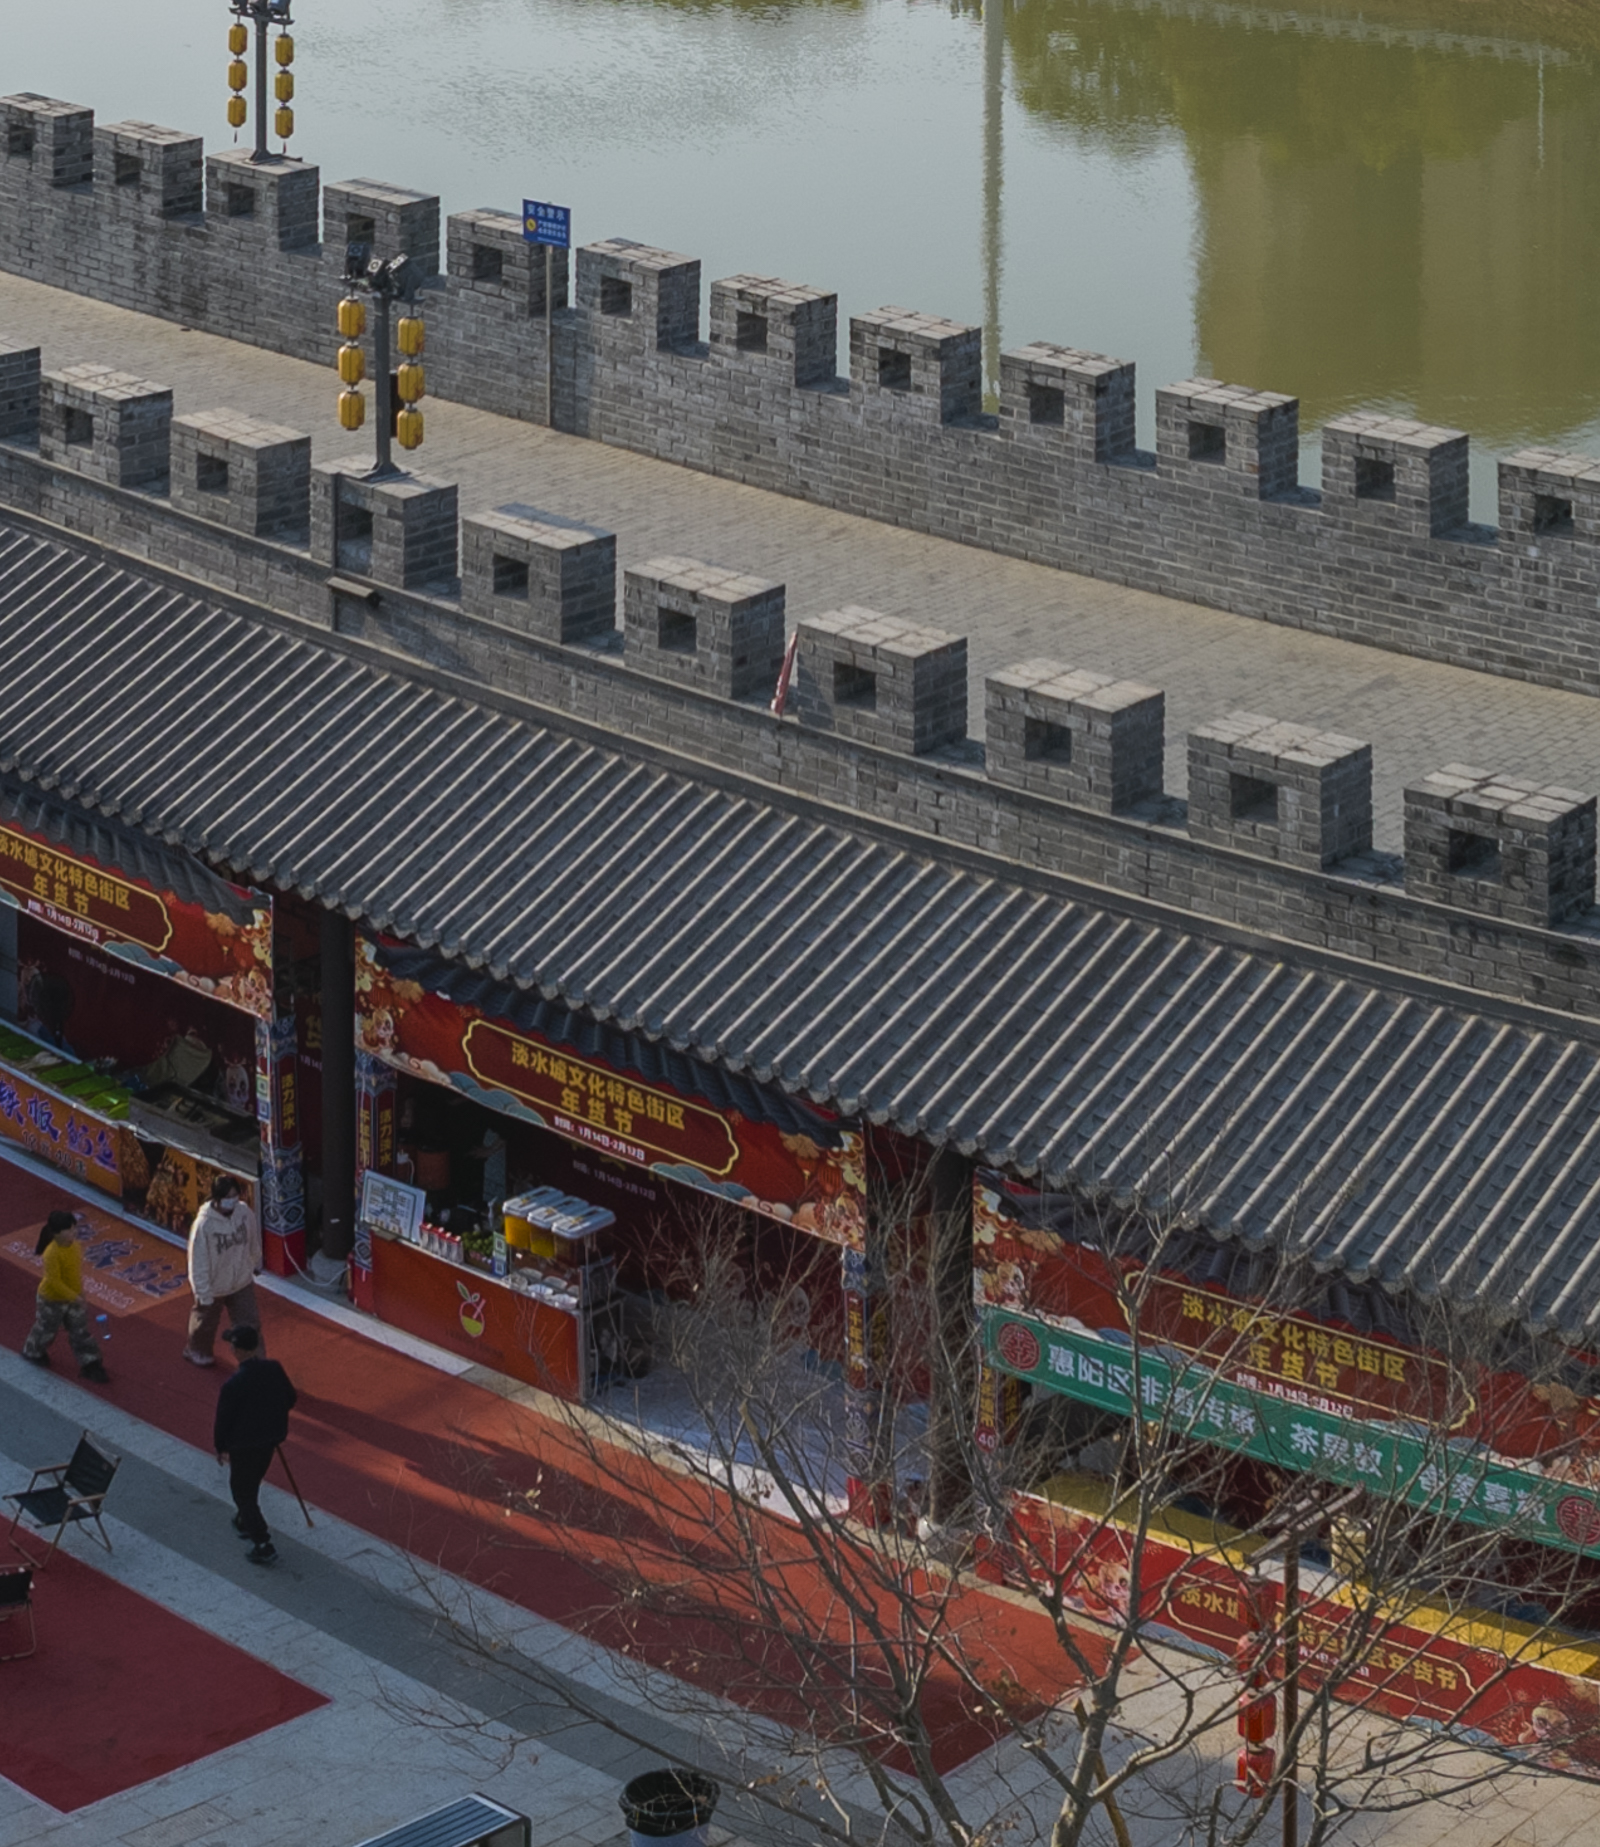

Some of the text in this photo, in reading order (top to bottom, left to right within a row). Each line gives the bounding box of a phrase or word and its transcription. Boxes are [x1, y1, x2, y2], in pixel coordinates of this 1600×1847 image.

[512, 1040, 686, 1132] 淡水墟文化特色街区
[561, 1086, 633, 1134] 年货节
[978, 1432, 995, 1449] 40
